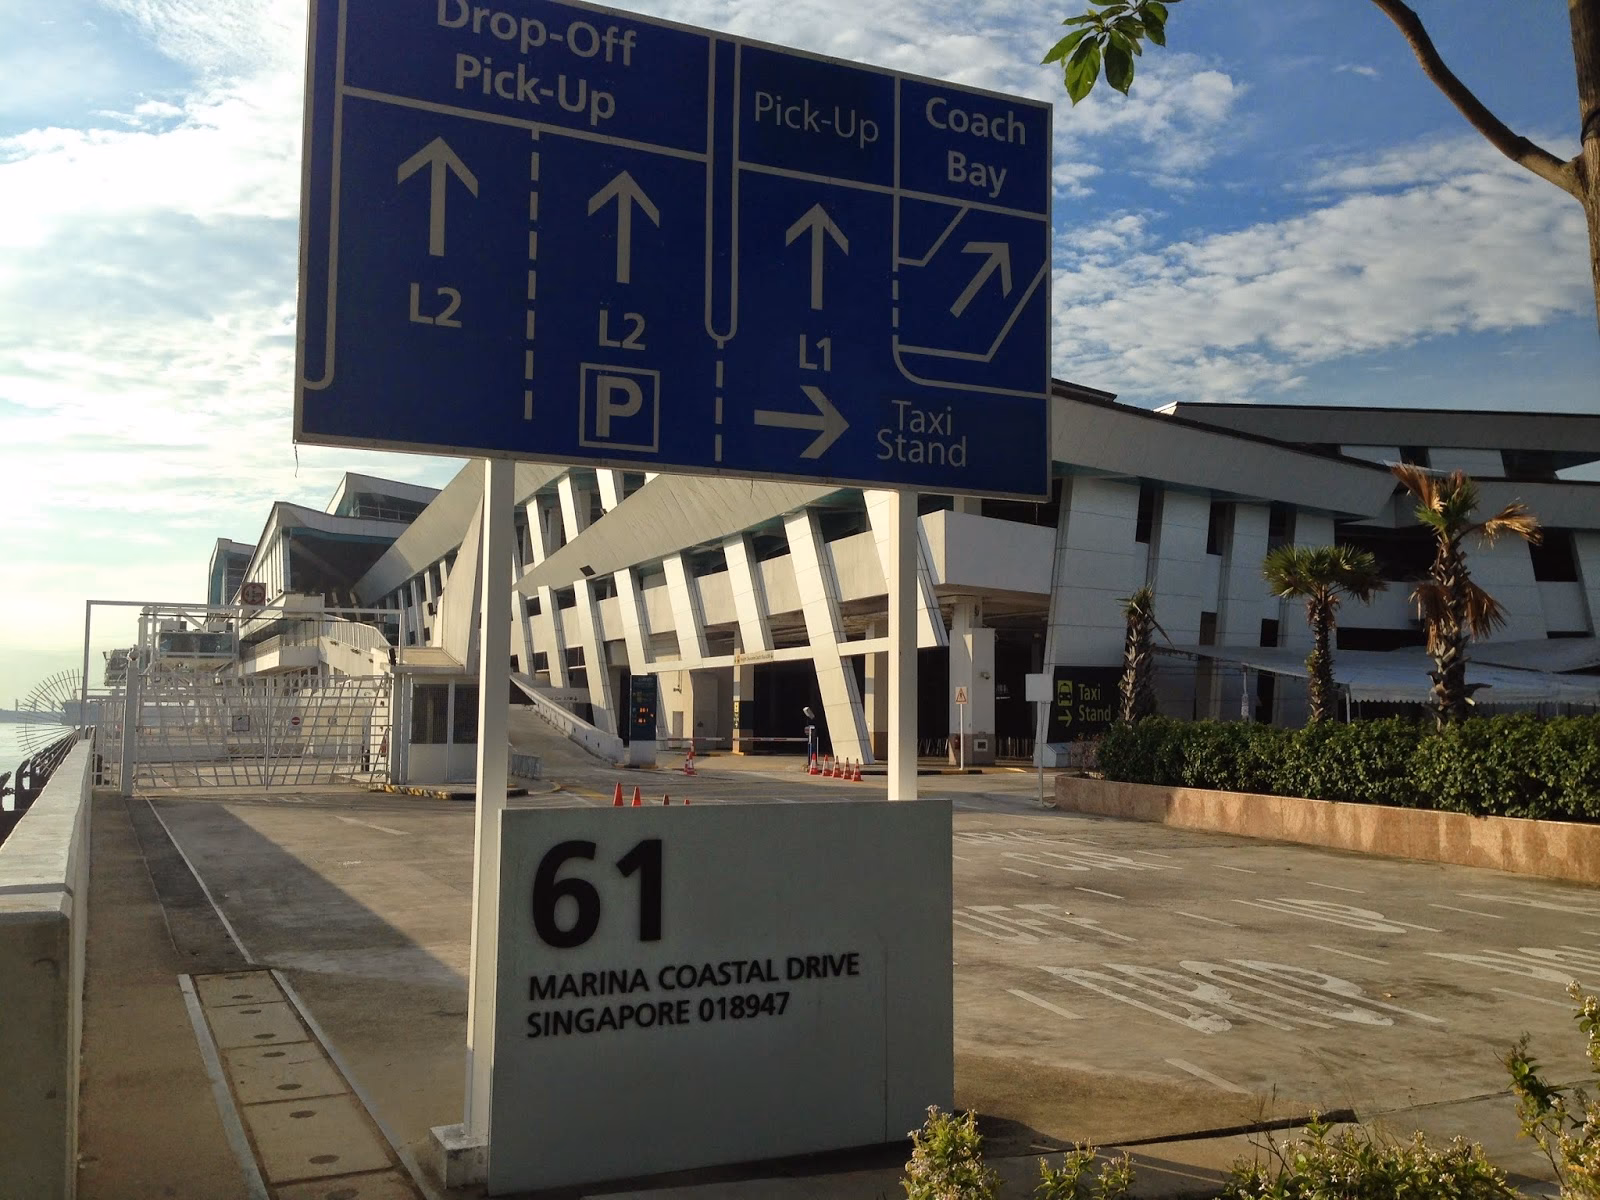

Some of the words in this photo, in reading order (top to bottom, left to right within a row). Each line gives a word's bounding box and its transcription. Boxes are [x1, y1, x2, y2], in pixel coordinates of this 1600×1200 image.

[437, 0, 637, 66] Drop-Off
[455, 53, 616, 126] Pick-Up
[754, 91, 879, 149] Pick-Up
[926, 96, 1026, 145] Coach
[948, 150, 1007, 198] Bay
[409, 282, 462, 328] L2
[599, 310, 646, 350] L2
[799, 333, 831, 372] L1
[595, 375, 643, 437] P
[892, 400, 952, 435] Taxi
[877, 429, 967, 467] Stand
[1078, 683, 1101, 701] Taxi
[1078, 704, 1112, 722] Stand
[1001, 851, 1184, 871] CAR
[531, 838, 663, 949] 61
[1230, 897, 1443, 933] UP
[528, 968, 648, 1000] MARINA
[658, 958, 779, 991] COASTAL
[786, 953, 860, 981] DRIVE
[1036, 957, 1445, 1034] DROP
[526, 1000, 690, 1038] SINGAPORE
[698, 991, 790, 1023] 018947
